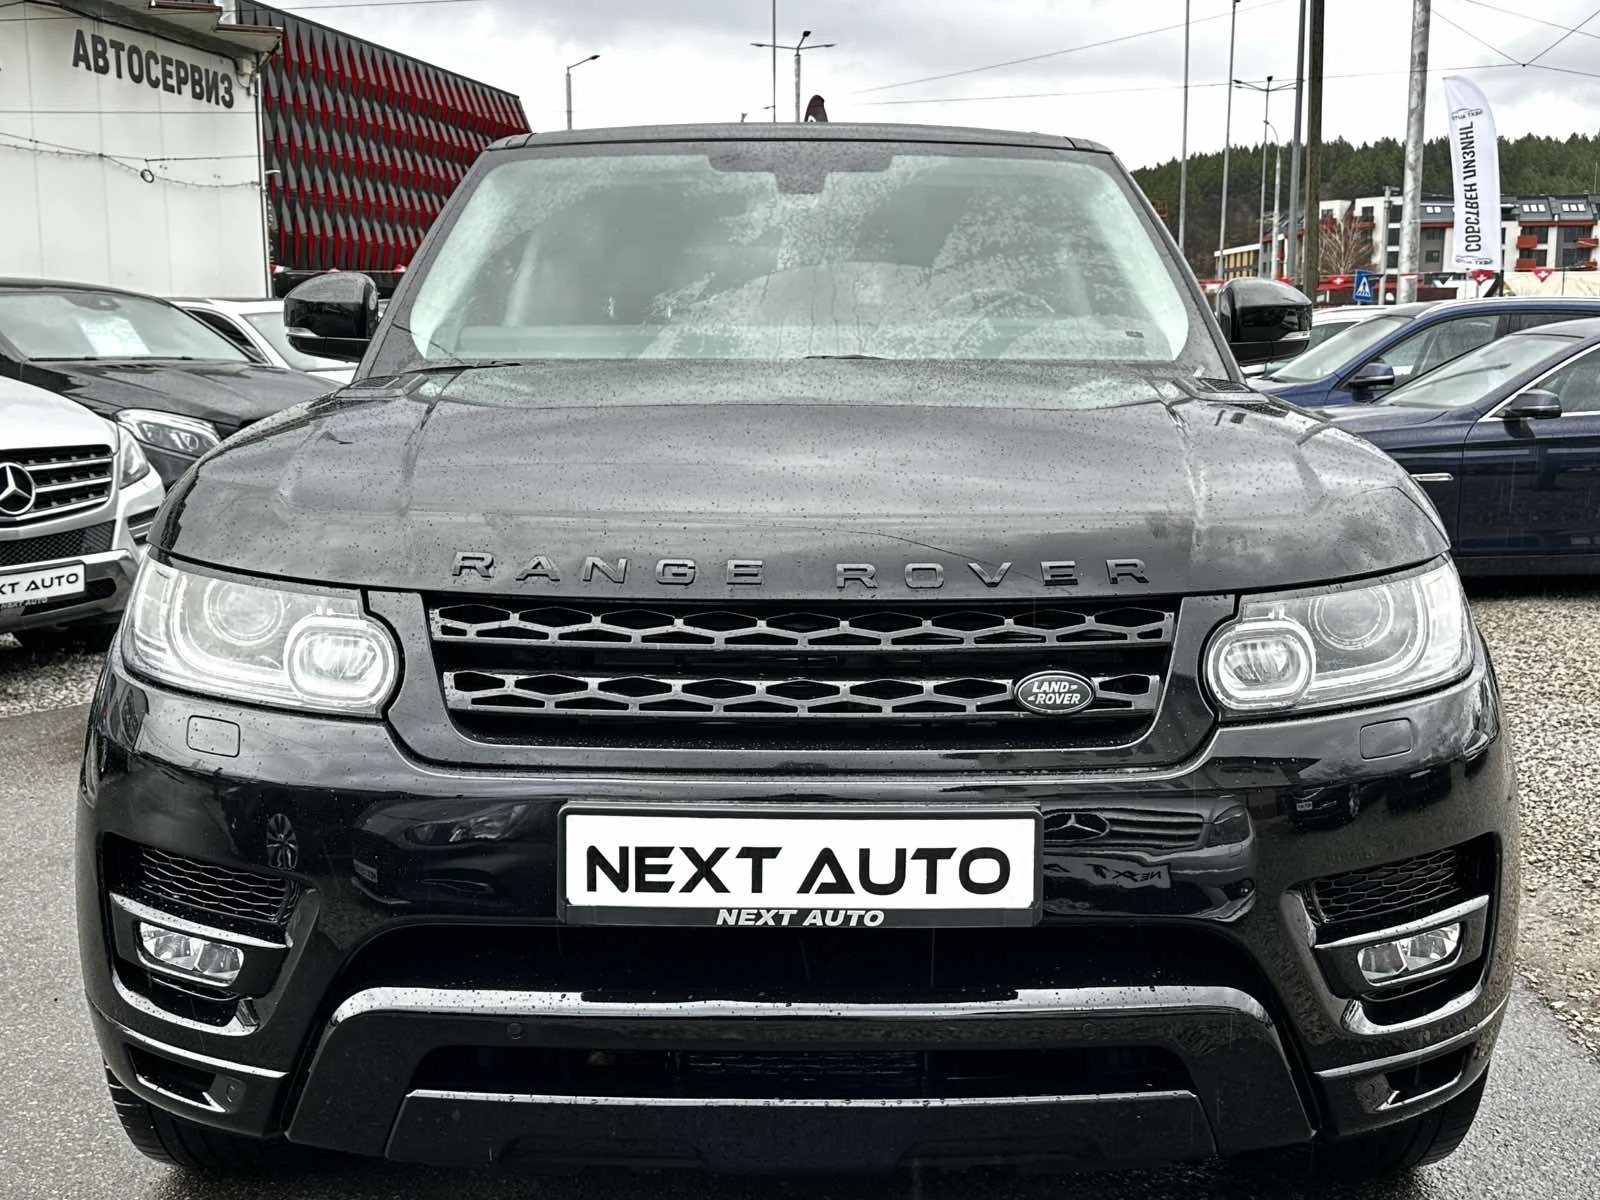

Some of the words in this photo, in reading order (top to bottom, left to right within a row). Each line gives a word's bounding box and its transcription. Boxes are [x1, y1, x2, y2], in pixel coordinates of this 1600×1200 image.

[72, 29, 234, 109] АВТОСЕРВИЗ
[452, 551, 763, 585] RANGE
[836, 558, 1149, 588] ROVER
[25, 573, 79, 592] AUTO
[1032, 681, 1069, 693] LAND
[1035, 693, 1081, 705] ROVER
[586, 845, 783, 893] NEXT
[796, 847, 1011, 895] AUTO
[715, 908, 798, 926] NEXT
[802, 909, 886, 926] AUTO
